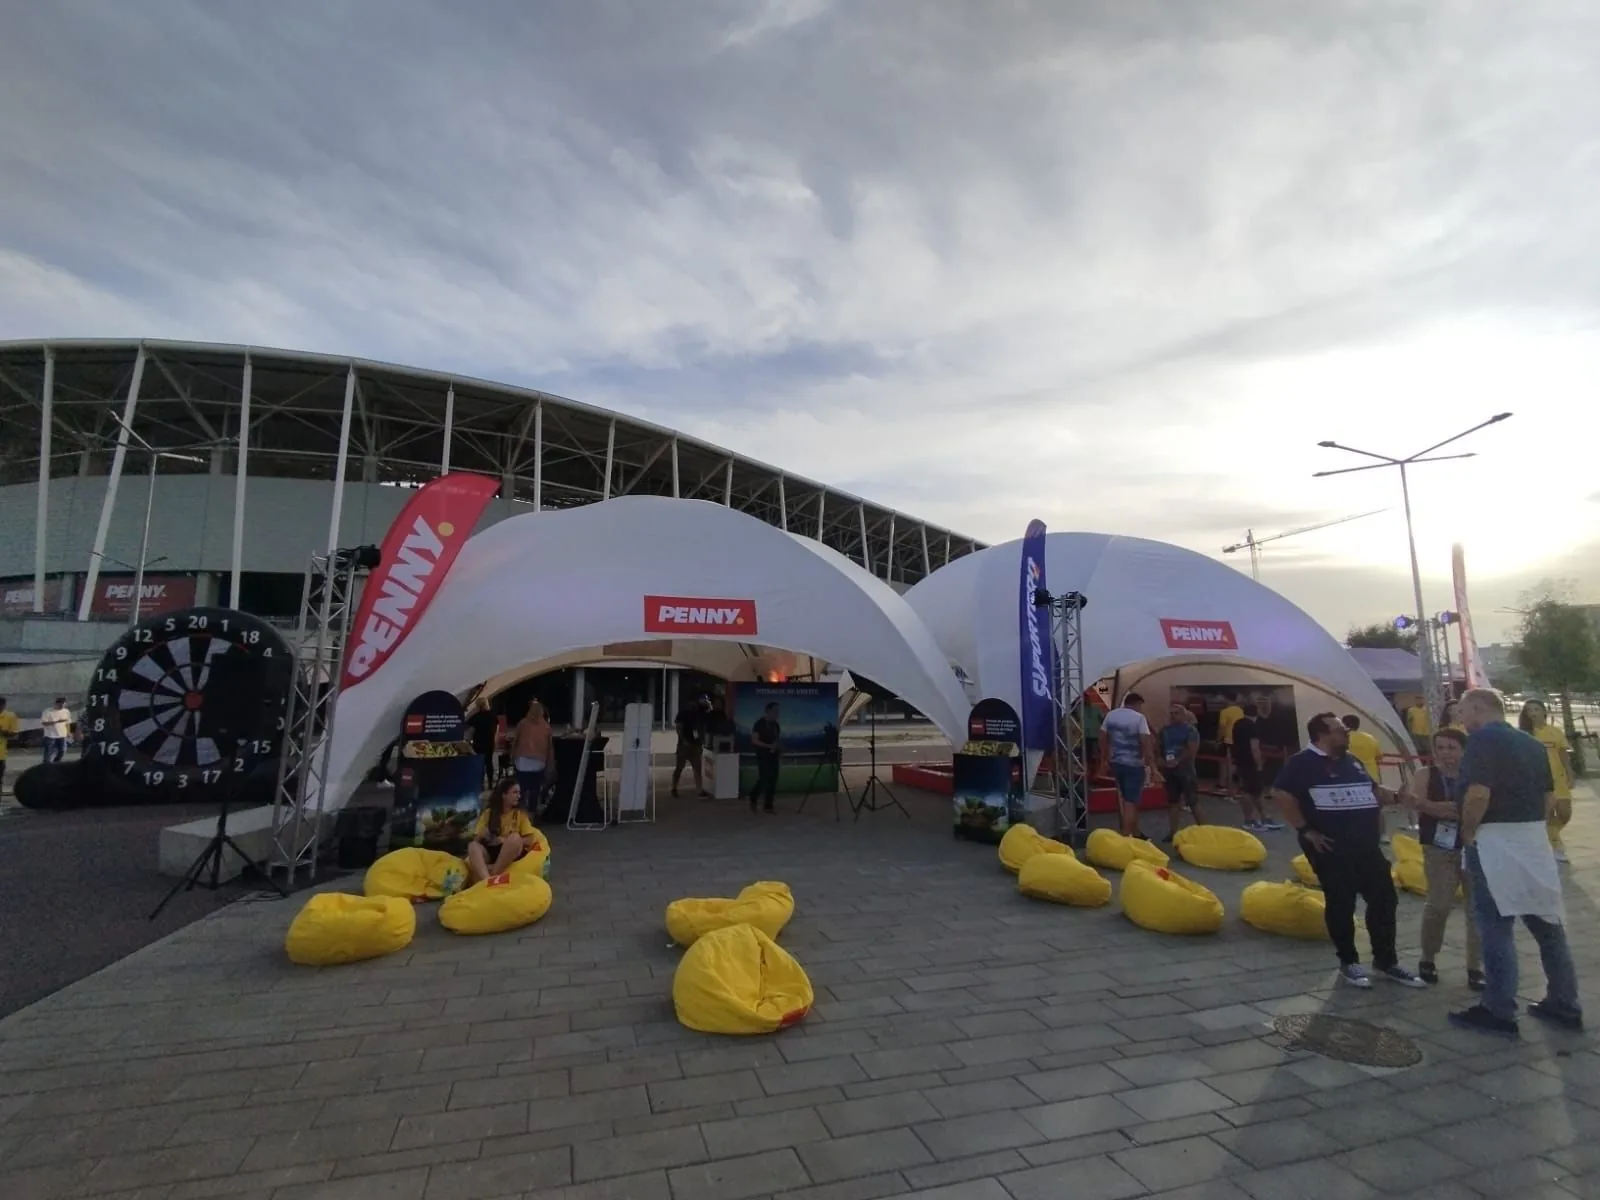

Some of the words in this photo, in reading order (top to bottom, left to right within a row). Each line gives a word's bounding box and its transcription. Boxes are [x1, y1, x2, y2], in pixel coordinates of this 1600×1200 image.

[165, 618, 176, 631] 5
[188, 615, 208, 629] 20
[221, 619, 229, 632] 1
[134, 629, 153, 643] 12
[240, 630, 260, 644] 18
[116, 646, 127, 660] 9
[262, 647, 273, 658] 4
[97, 668, 118, 682] 14
[91, 694, 109, 707] 11
[94, 718, 105, 732] 8
[98, 741, 120, 755] 16
[252, 740, 272, 754] 15
[124, 760, 136, 775] 7
[234, 758, 245, 772] 2
[143, 771, 164, 785] 19
[177, 774, 188, 788] 3
[202, 770, 222, 784] 17
